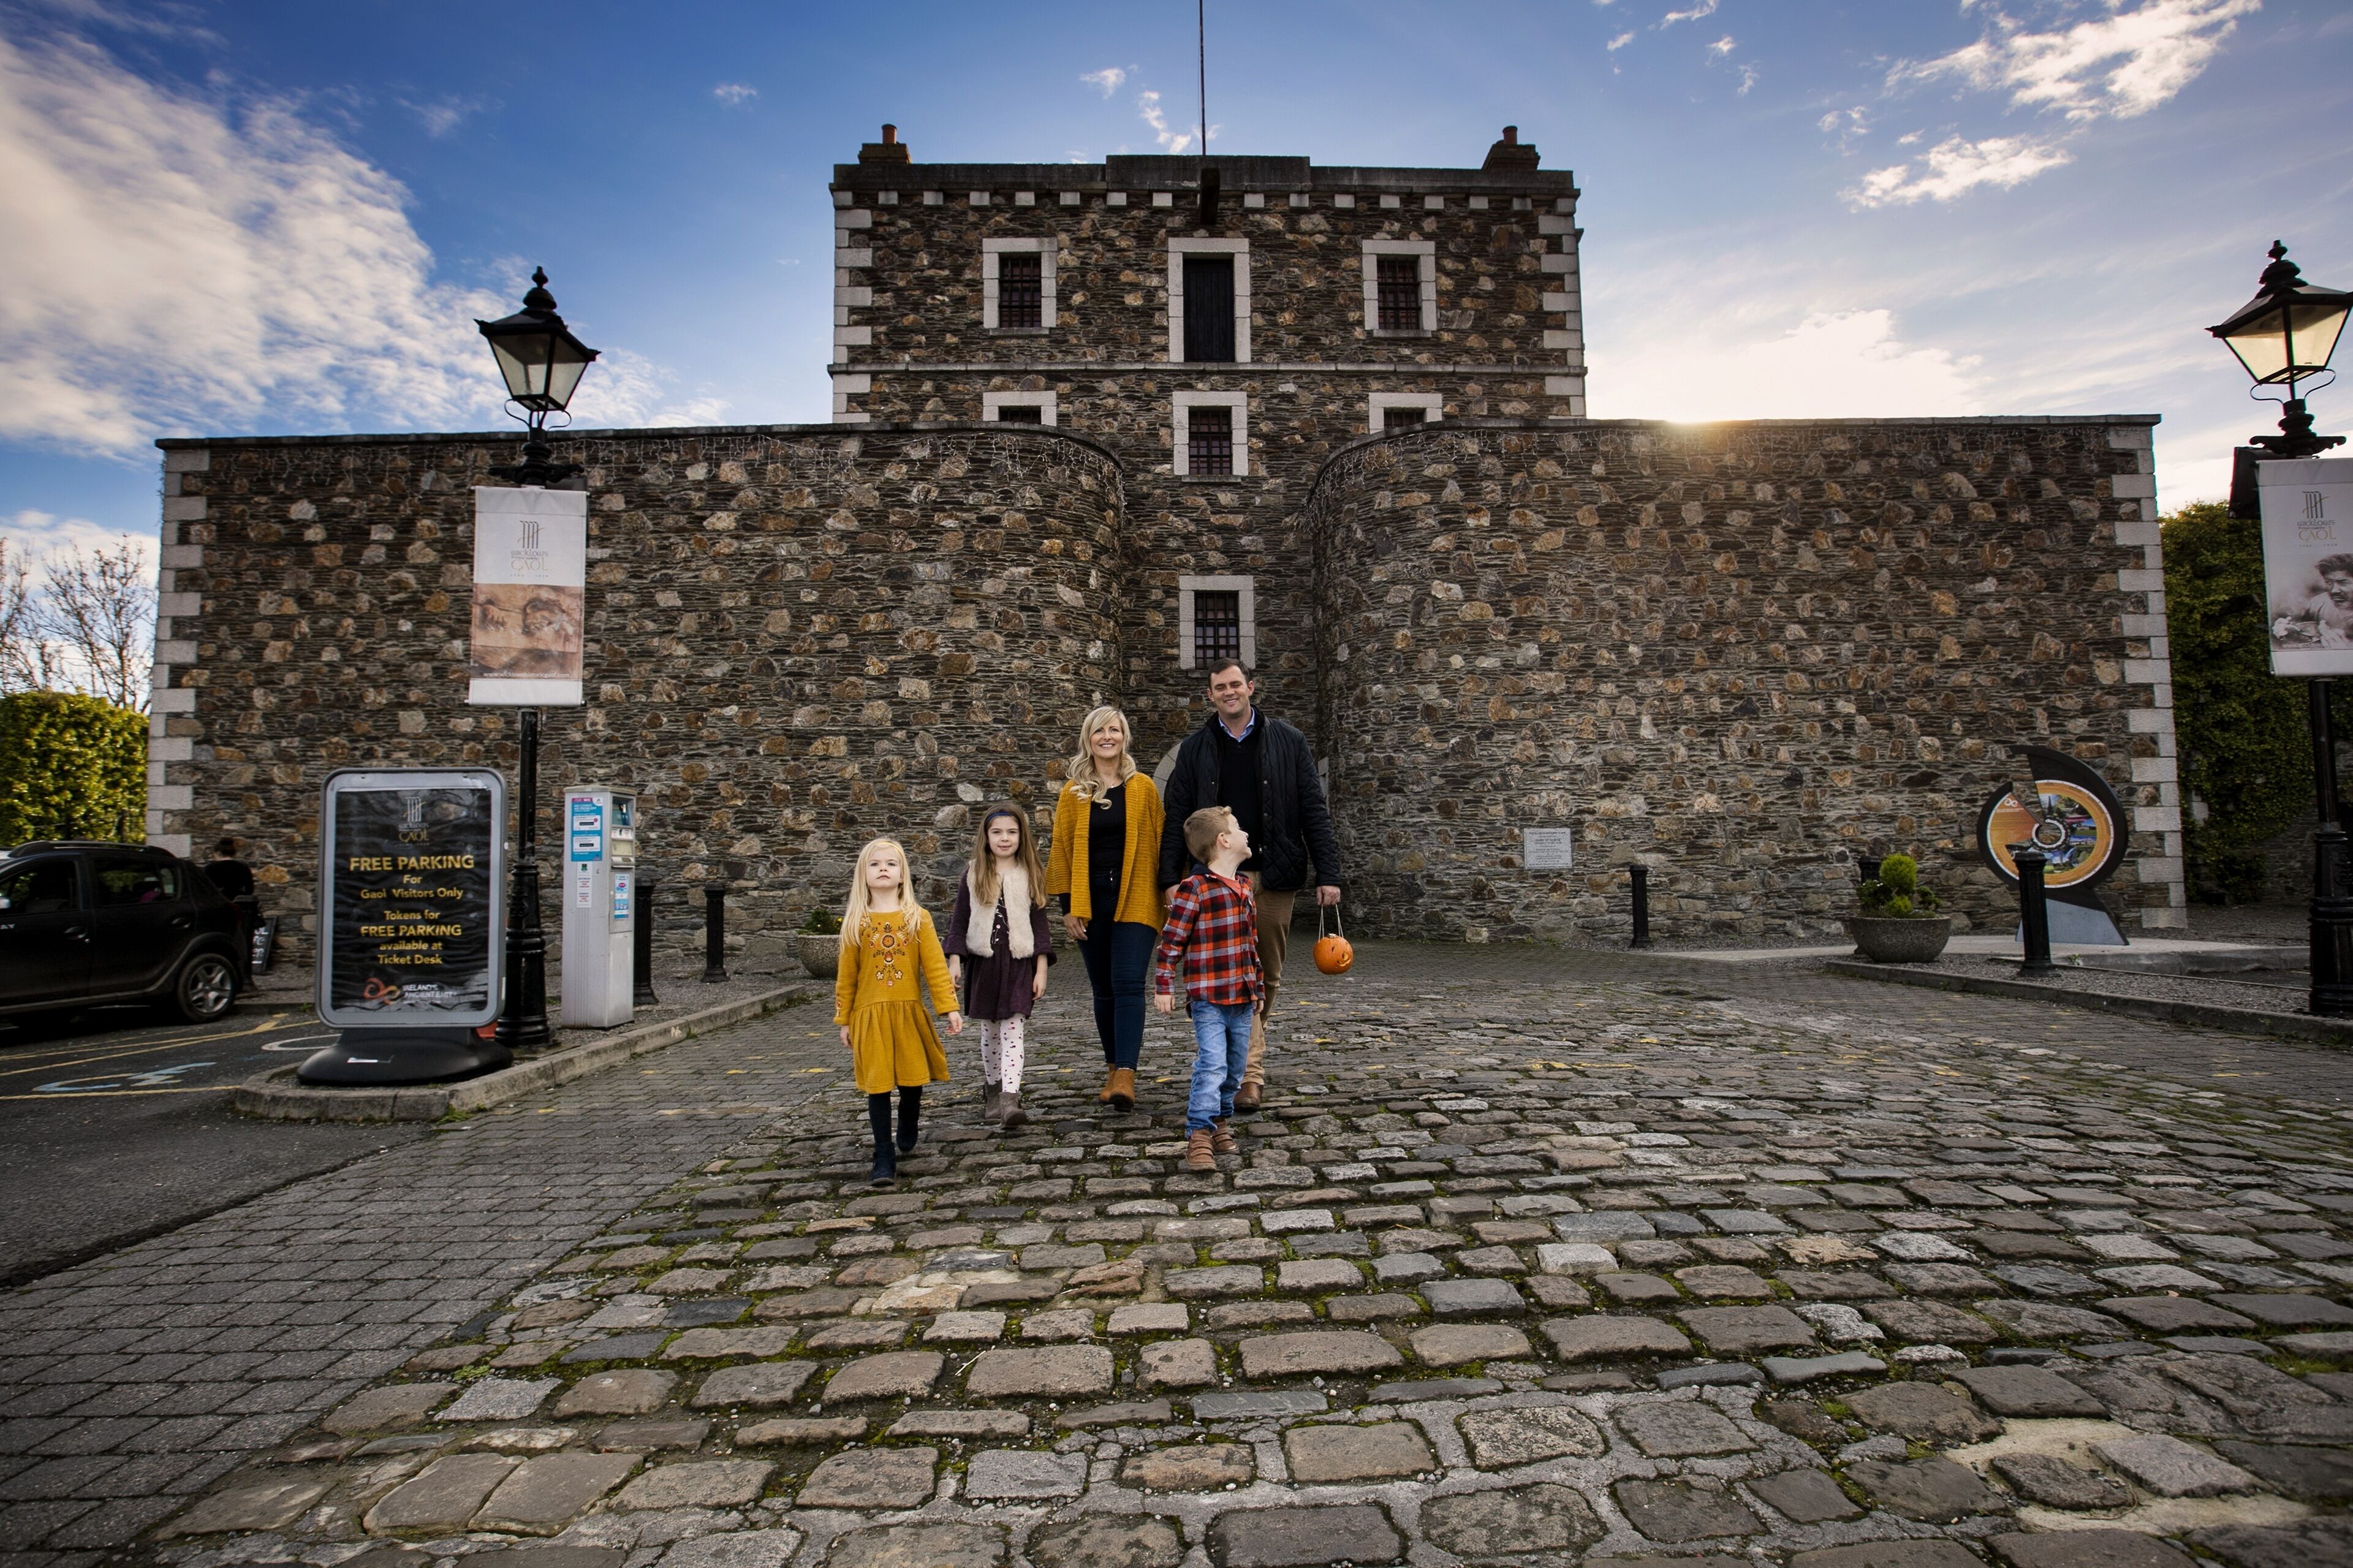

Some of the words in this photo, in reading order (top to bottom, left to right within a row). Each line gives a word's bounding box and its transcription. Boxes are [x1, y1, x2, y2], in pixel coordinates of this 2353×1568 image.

[350, 857, 393, 871] FREE
[398, 855, 474, 869] PARKING
[403, 874, 422, 884] For
[392, 888, 434, 898] Visitors
[436, 887, 463, 900] Only
[384, 911, 422, 920] Tokens
[423, 909, 441, 919] for
[360, 926, 395, 936] FREE
[399, 925, 461, 936] PARKING
[379, 940, 428, 950] available
[431, 941, 442, 950] at
[377, 955, 411, 964] Ticket
[414, 954, 442, 964] Desk
